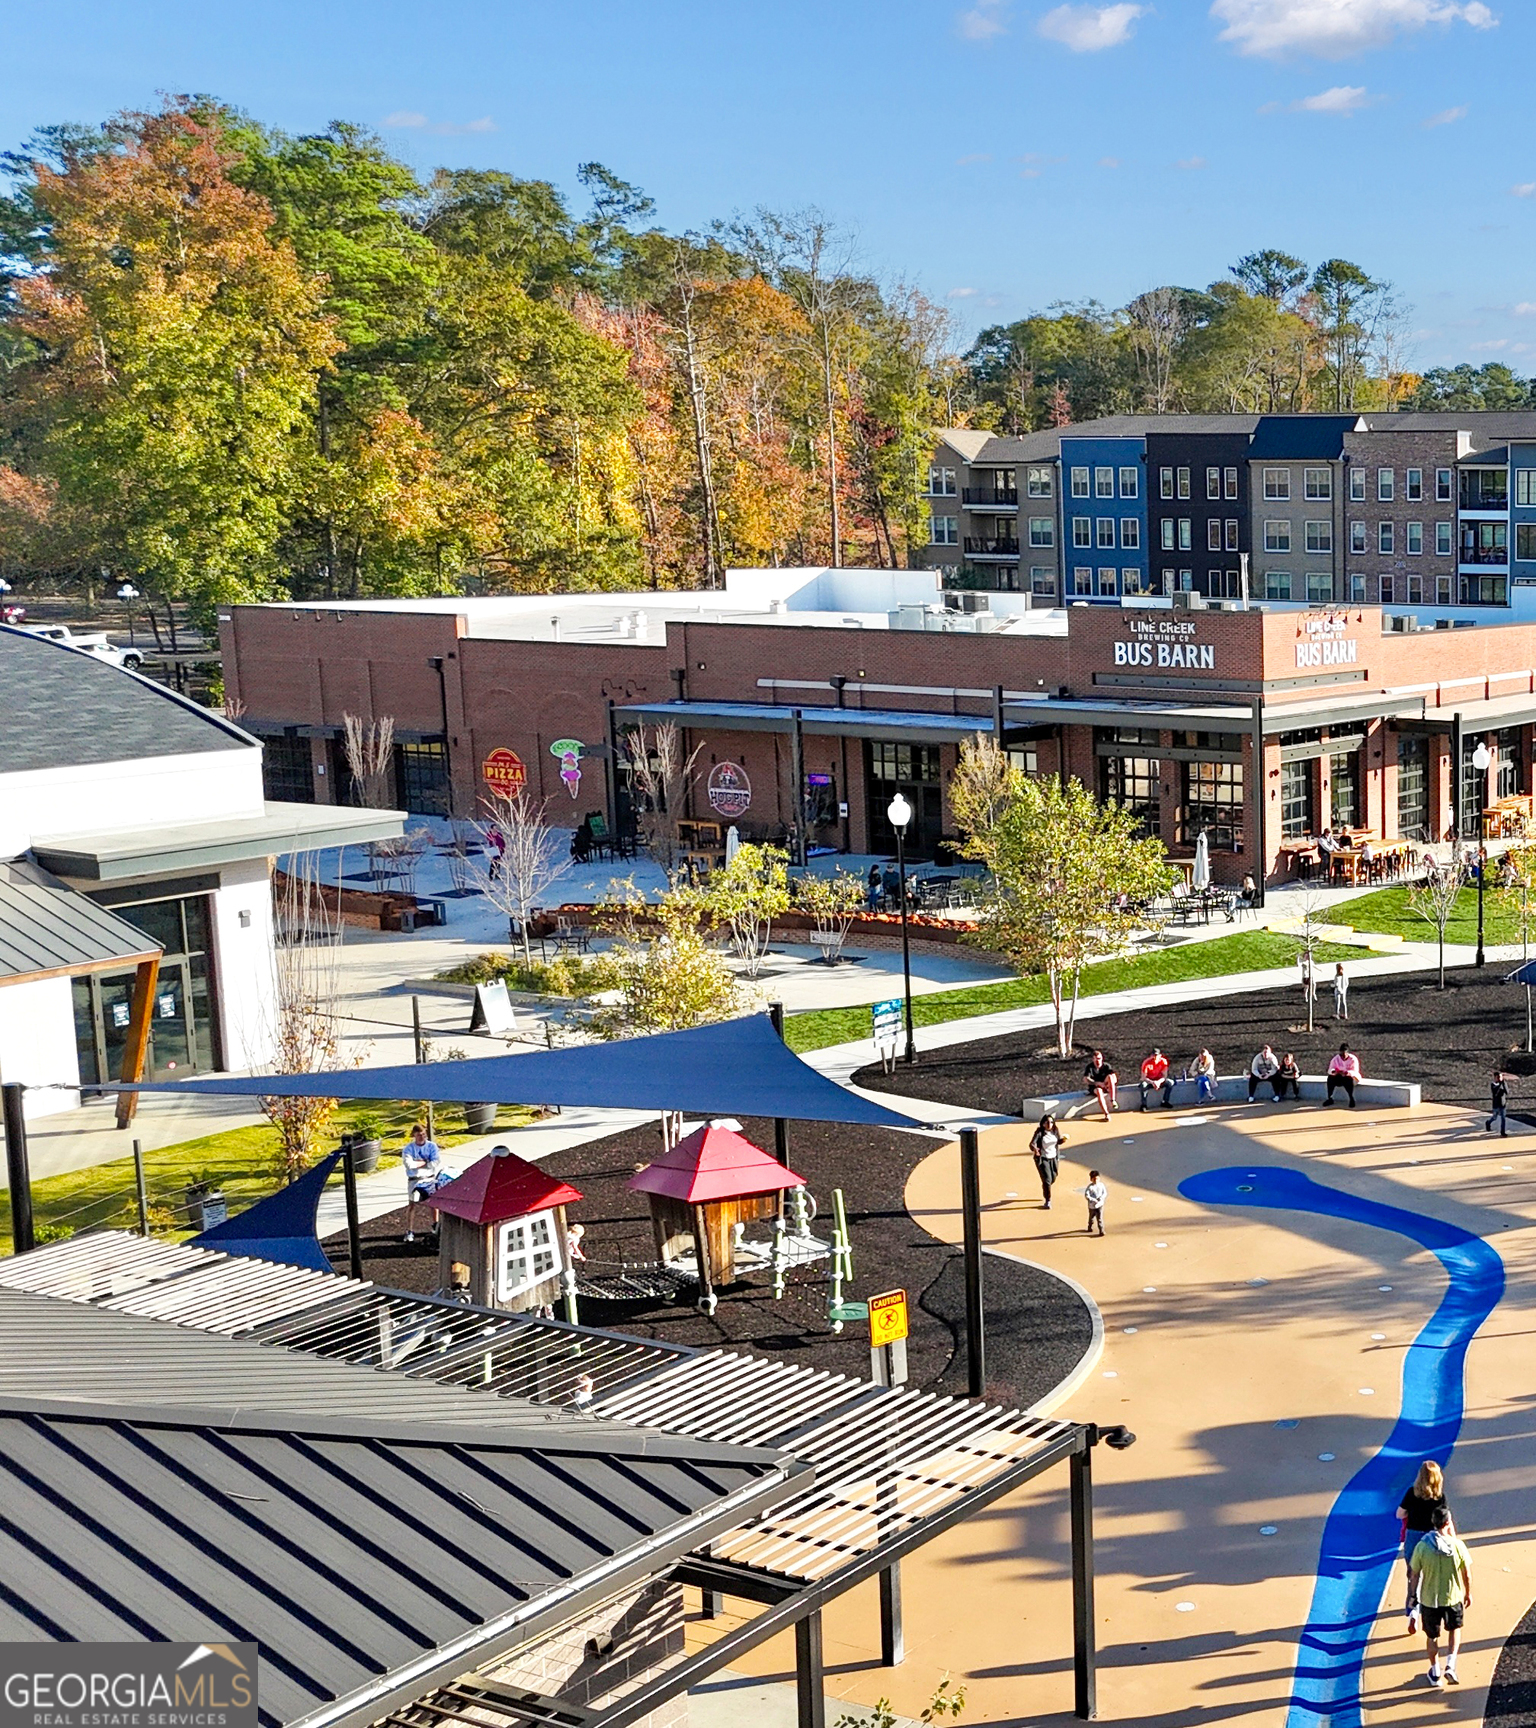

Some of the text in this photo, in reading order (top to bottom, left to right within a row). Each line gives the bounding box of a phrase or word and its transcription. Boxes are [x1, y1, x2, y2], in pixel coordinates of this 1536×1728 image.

[1130, 621, 1196, 634] LINE CREEK
[1138, 633, 1176, 642] BREWING
[1114, 642, 1215, 670] BUS BARN
[1295, 640, 1357, 668] BUS BARN
[486, 766, 523, 781] PIZZA
[873, 1294, 902, 1309] CAUTION
